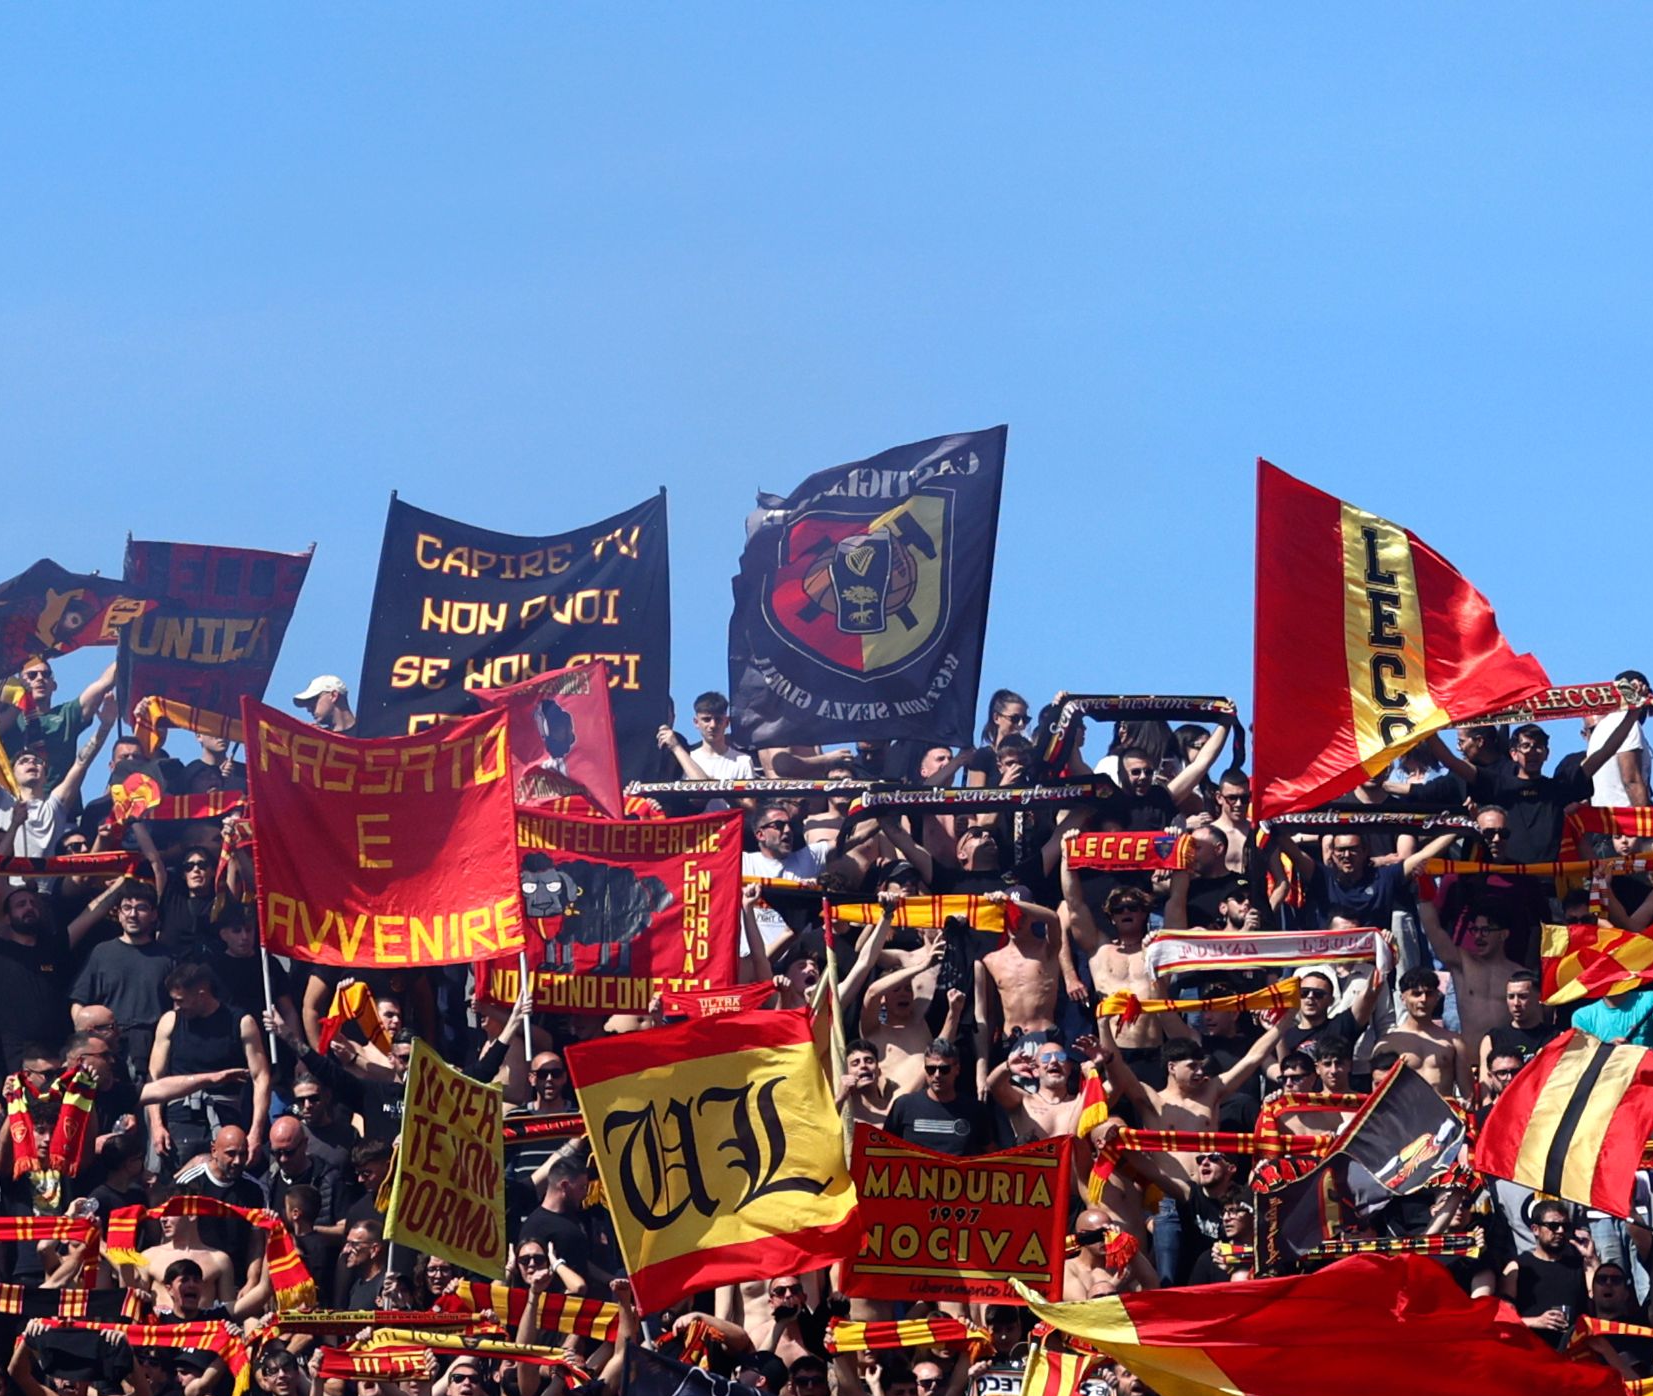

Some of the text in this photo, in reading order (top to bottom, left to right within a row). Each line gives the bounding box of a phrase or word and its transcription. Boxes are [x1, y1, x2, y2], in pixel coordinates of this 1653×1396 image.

[415, 534, 572, 580] CAPIRE
[421, 588, 621, 636] NON PUOI
[391, 654, 450, 689] SE
[464, 653, 548, 690] NON
[1532, 683, 1617, 711] LECCE
[258, 717, 508, 796] PASSATO
[953, 787, 1013, 803] senza
[1020, 783, 1084, 806] gloria
[355, 812, 394, 869] E
[563, 824, 636, 854] FELICE
[1069, 834, 1149, 862] LECCE
[265, 889, 525, 964] AVVENIRE
[683, 859, 698, 975] CURVA
[698, 870, 711, 961] NORD
[1176, 942, 1259, 959] FORZA
[409, 1119, 448, 1176] TE
[862, 1164, 1053, 1208] MANDURIA
[927, 1207, 982, 1225] 1997
[857, 1225, 1048, 1267] NOCIVA
